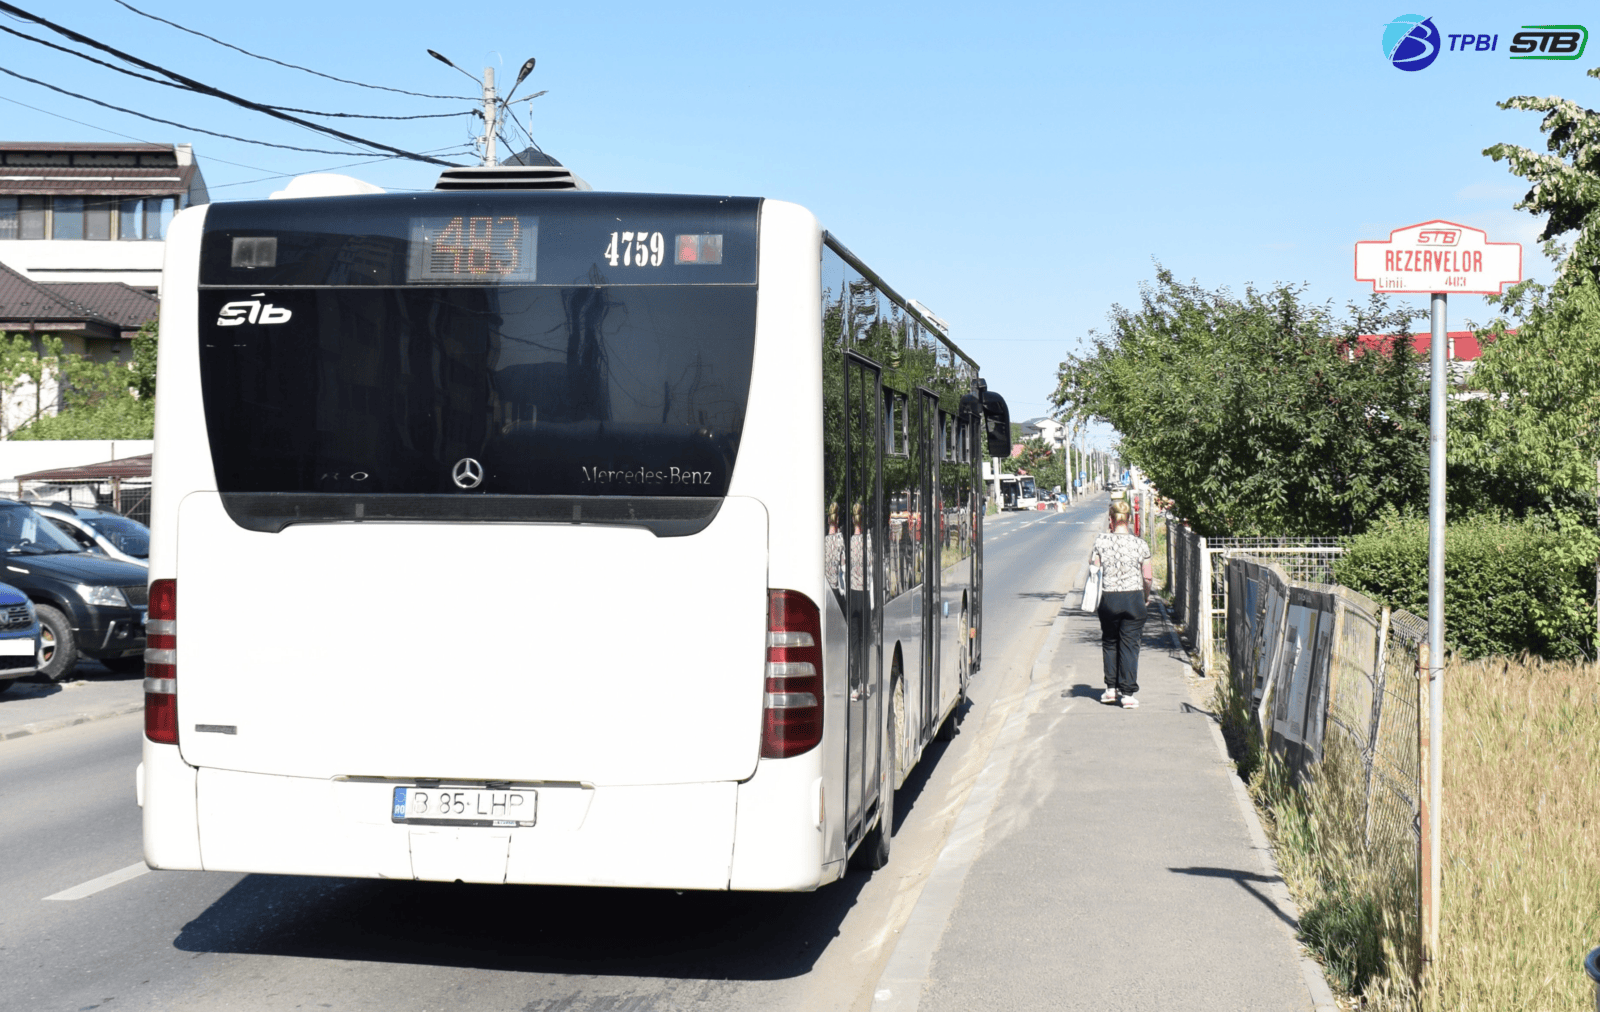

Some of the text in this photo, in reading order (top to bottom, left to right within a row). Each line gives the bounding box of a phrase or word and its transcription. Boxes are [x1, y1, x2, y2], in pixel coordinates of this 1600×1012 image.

[435, 216, 519, 274] 483
[604, 231, 665, 266] 4759
[1417, 230, 1456, 244] STB
[1385, 249, 1483, 272] REZERVELOR
[582, 466, 712, 484] Mercedes-Benz
[394, 792, 525, 816] RO B 85 LHP
